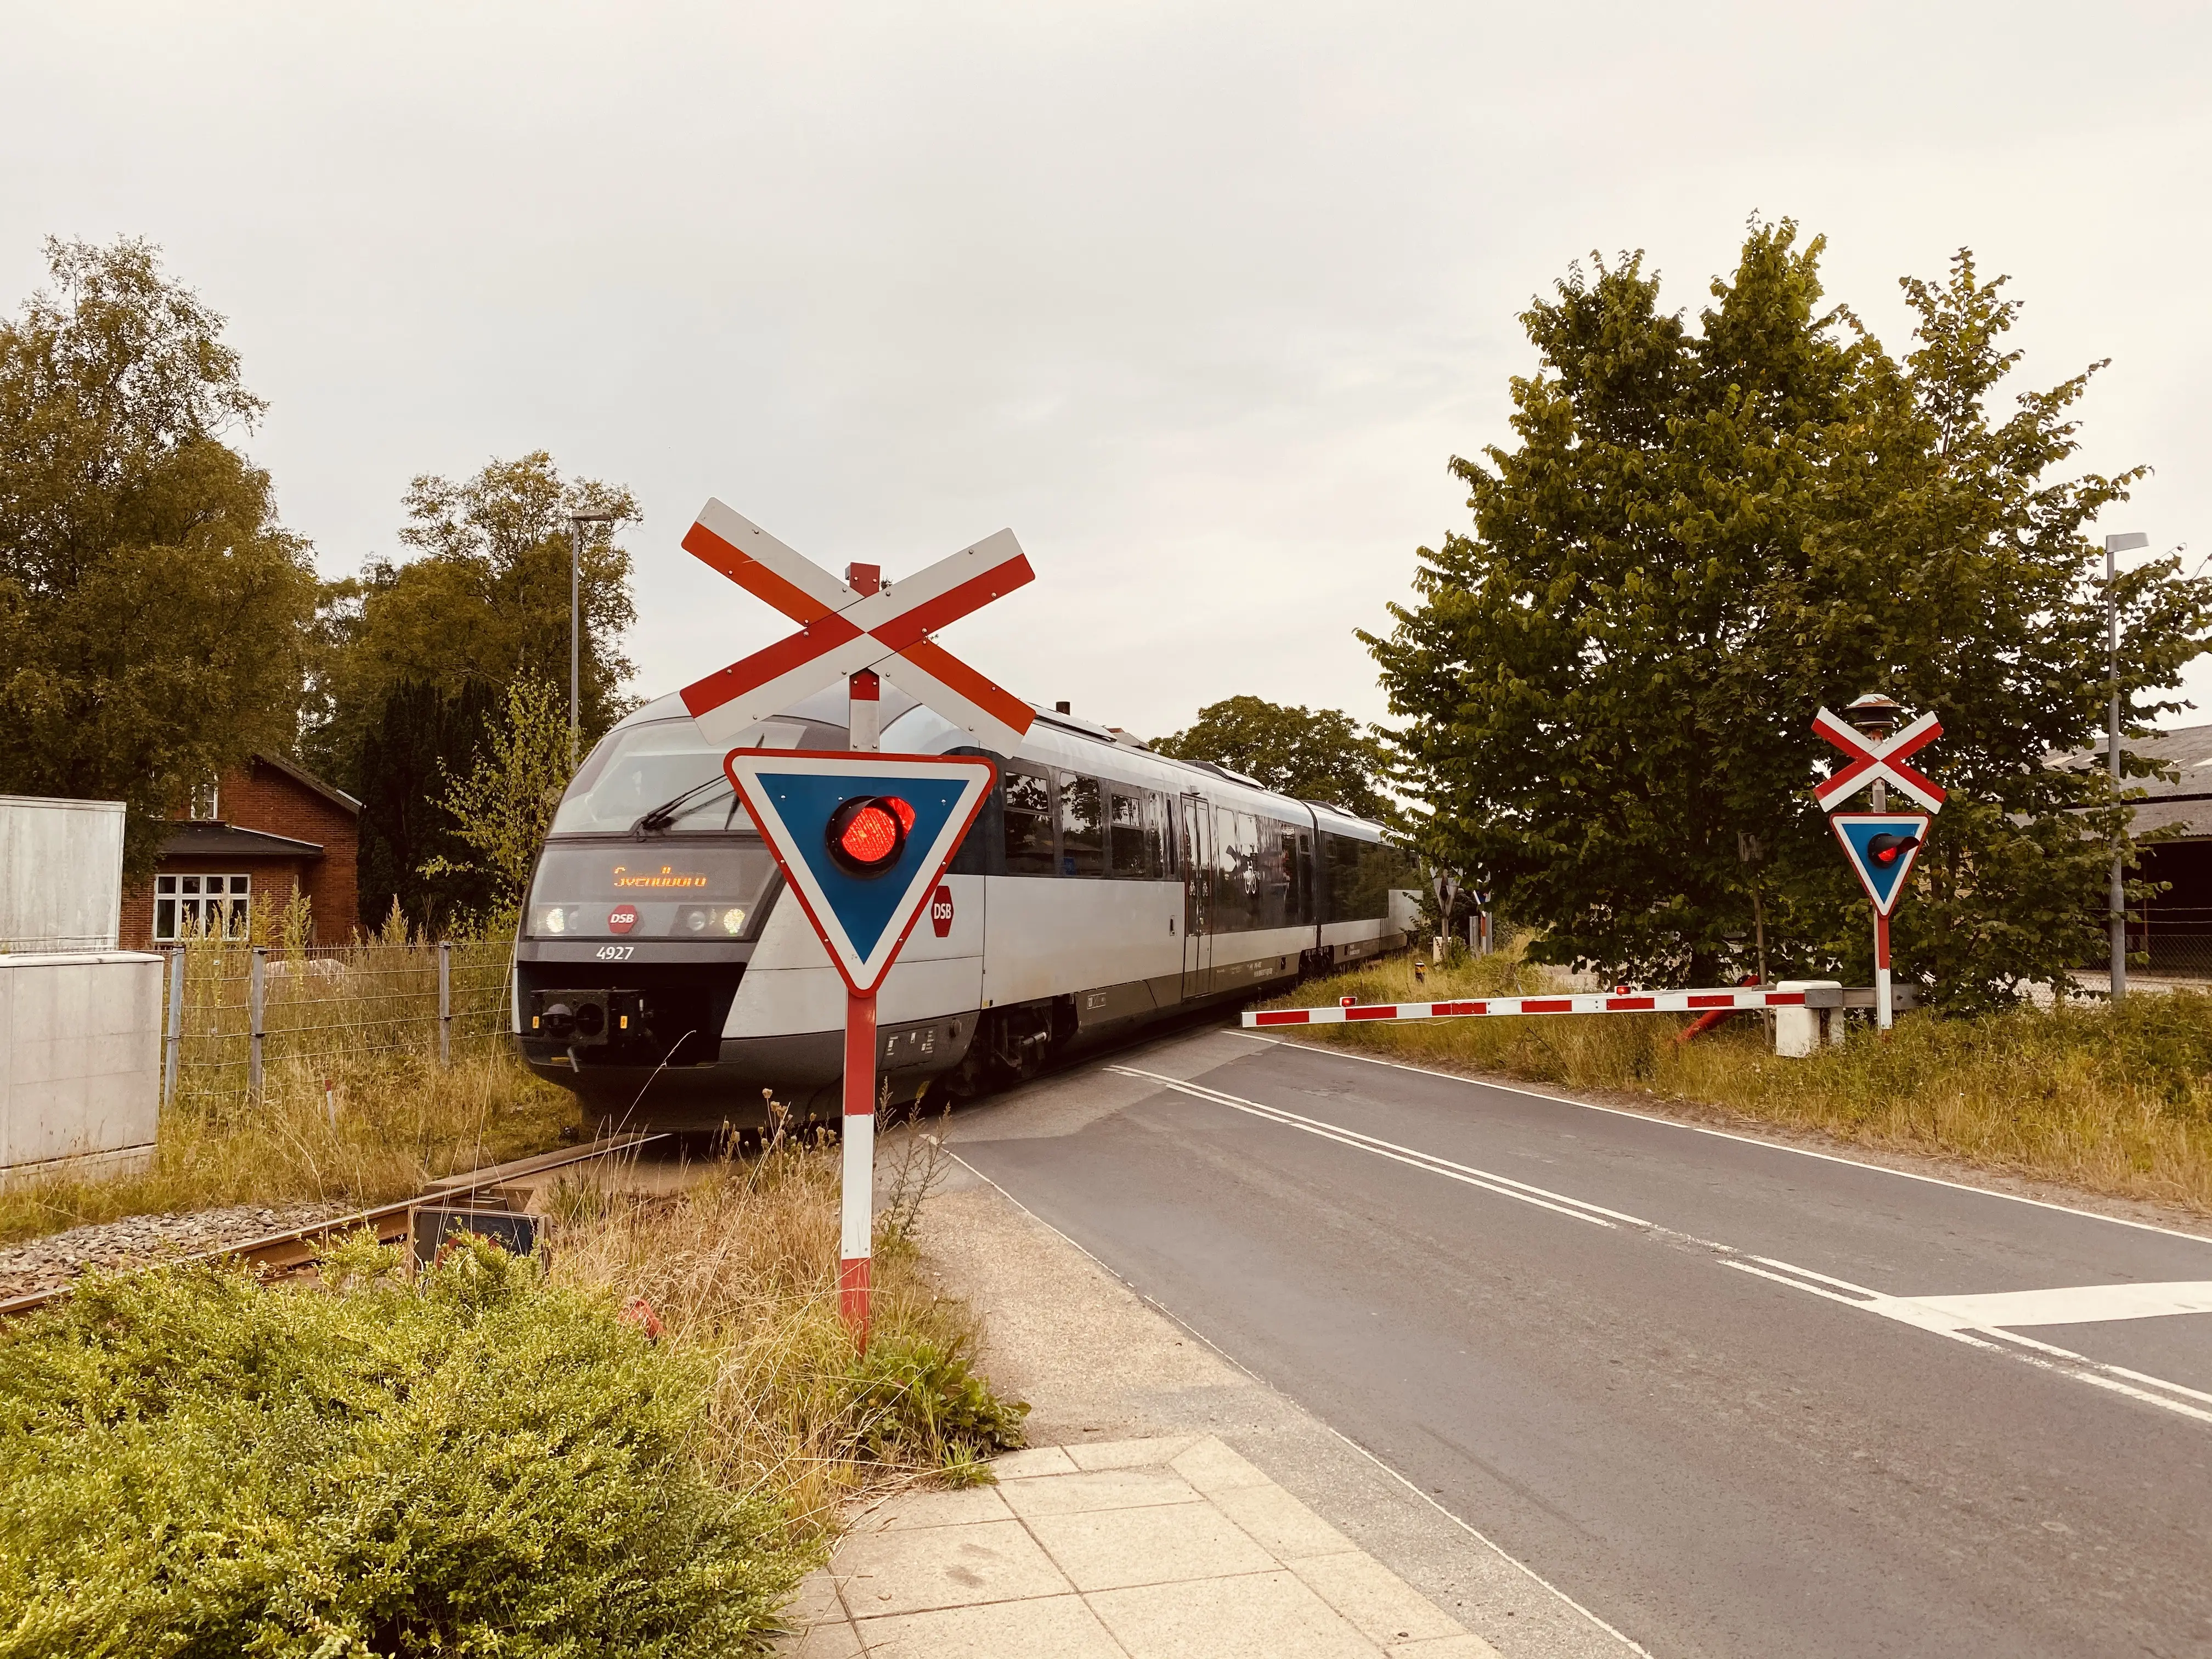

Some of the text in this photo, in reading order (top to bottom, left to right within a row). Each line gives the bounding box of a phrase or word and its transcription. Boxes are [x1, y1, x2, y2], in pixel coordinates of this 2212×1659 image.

[610, 913, 634, 923] DSB
[934, 903, 951, 919] DSB
[596, 946, 635, 960] 4927
